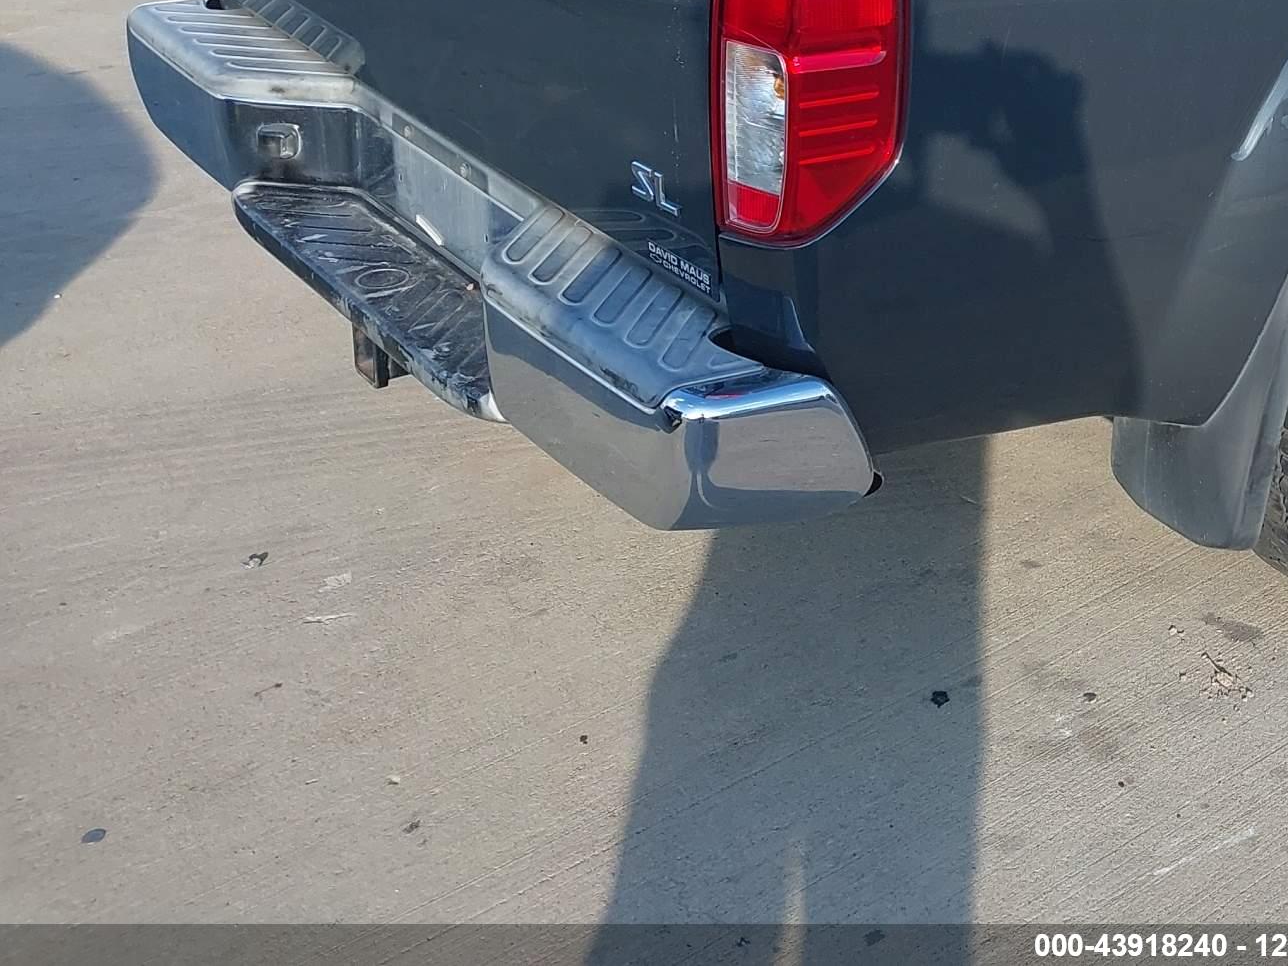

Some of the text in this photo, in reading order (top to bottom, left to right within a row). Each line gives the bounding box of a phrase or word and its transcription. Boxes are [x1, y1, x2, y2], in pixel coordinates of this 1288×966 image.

[631, 160, 679, 217] SL
[647, 240, 712, 286] DAVID MAUS
[662, 260, 712, 295] CHEVROLET
